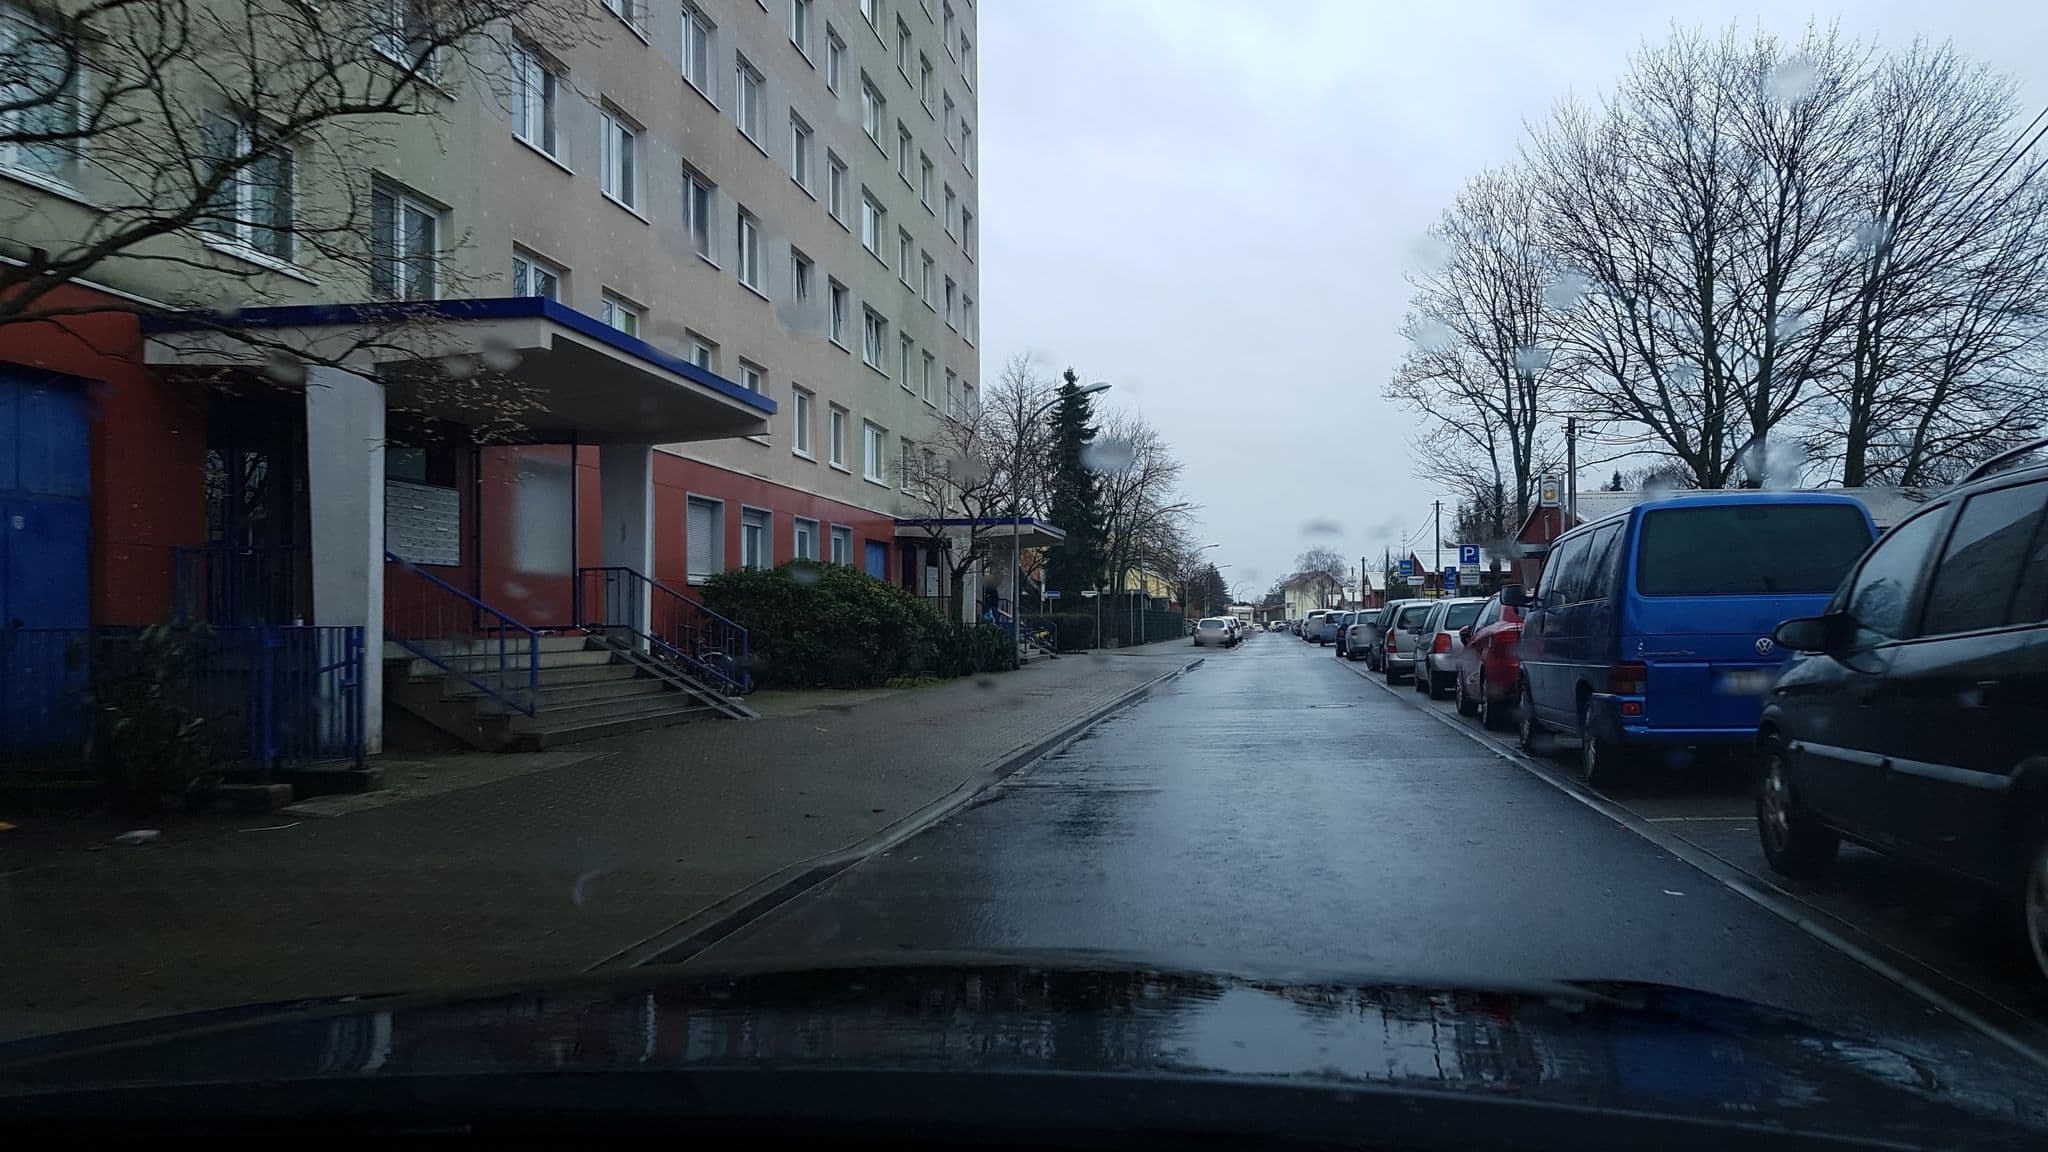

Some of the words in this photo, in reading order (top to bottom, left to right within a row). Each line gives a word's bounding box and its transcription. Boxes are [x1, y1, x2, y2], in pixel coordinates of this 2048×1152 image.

[1464, 547, 1475, 561] P
[1446, 568, 1452, 577] P
[1755, 637, 1774, 655] VW
